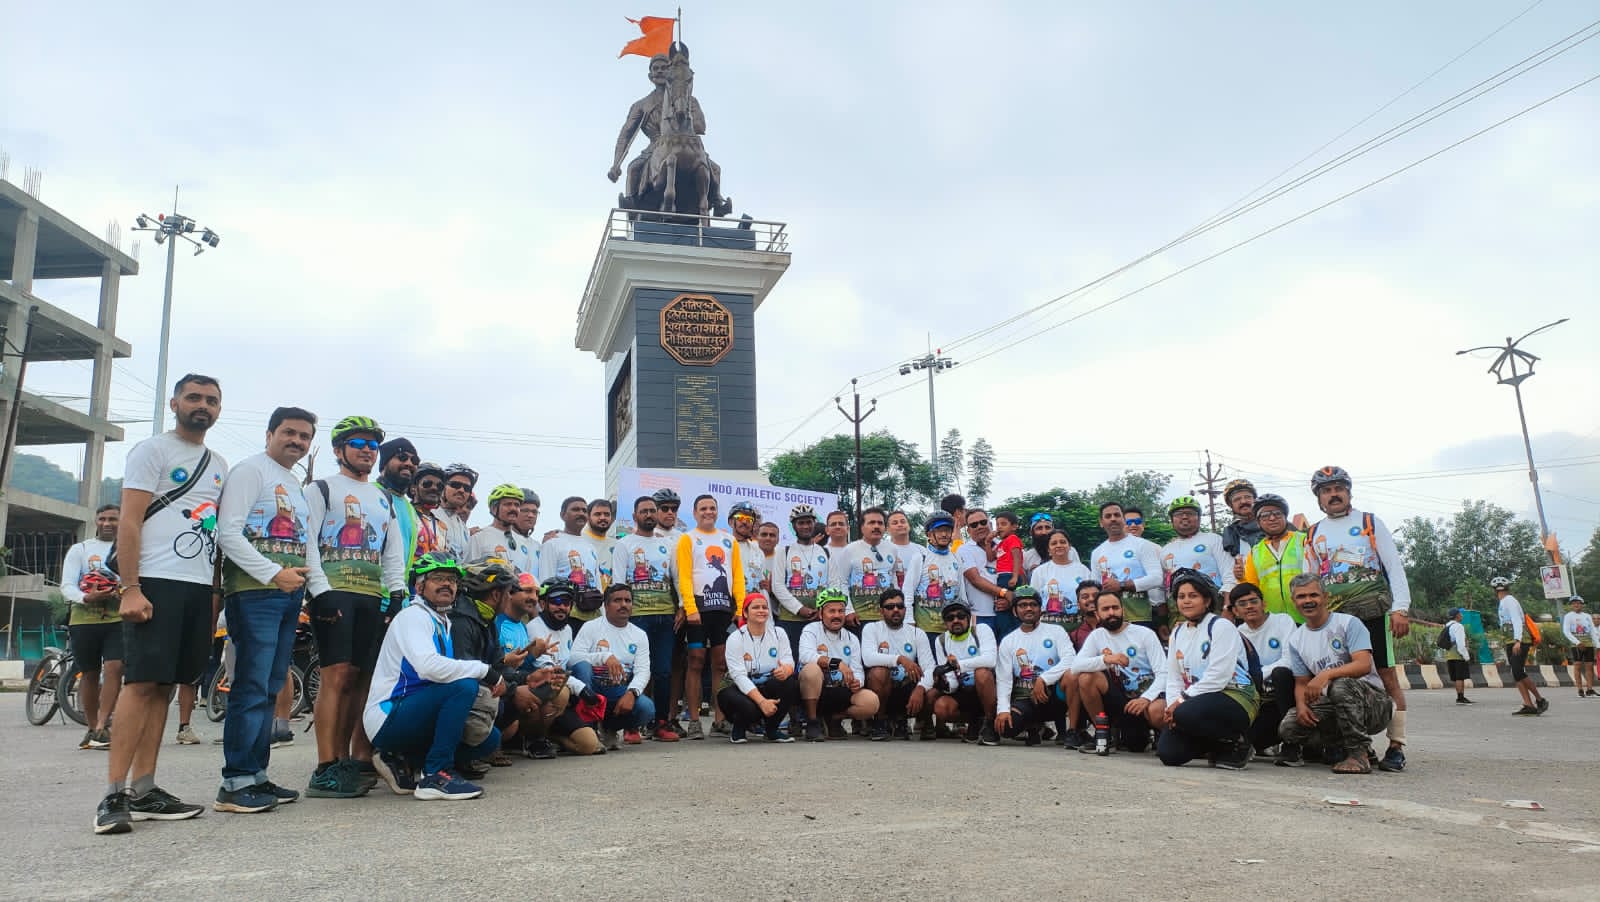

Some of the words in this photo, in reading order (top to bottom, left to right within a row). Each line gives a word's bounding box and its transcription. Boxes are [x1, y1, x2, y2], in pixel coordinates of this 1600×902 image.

[708, 483, 732, 495] INDO
[736, 487, 781, 500] ATHLETIC
[785, 492, 825, 506] SOCIETY
